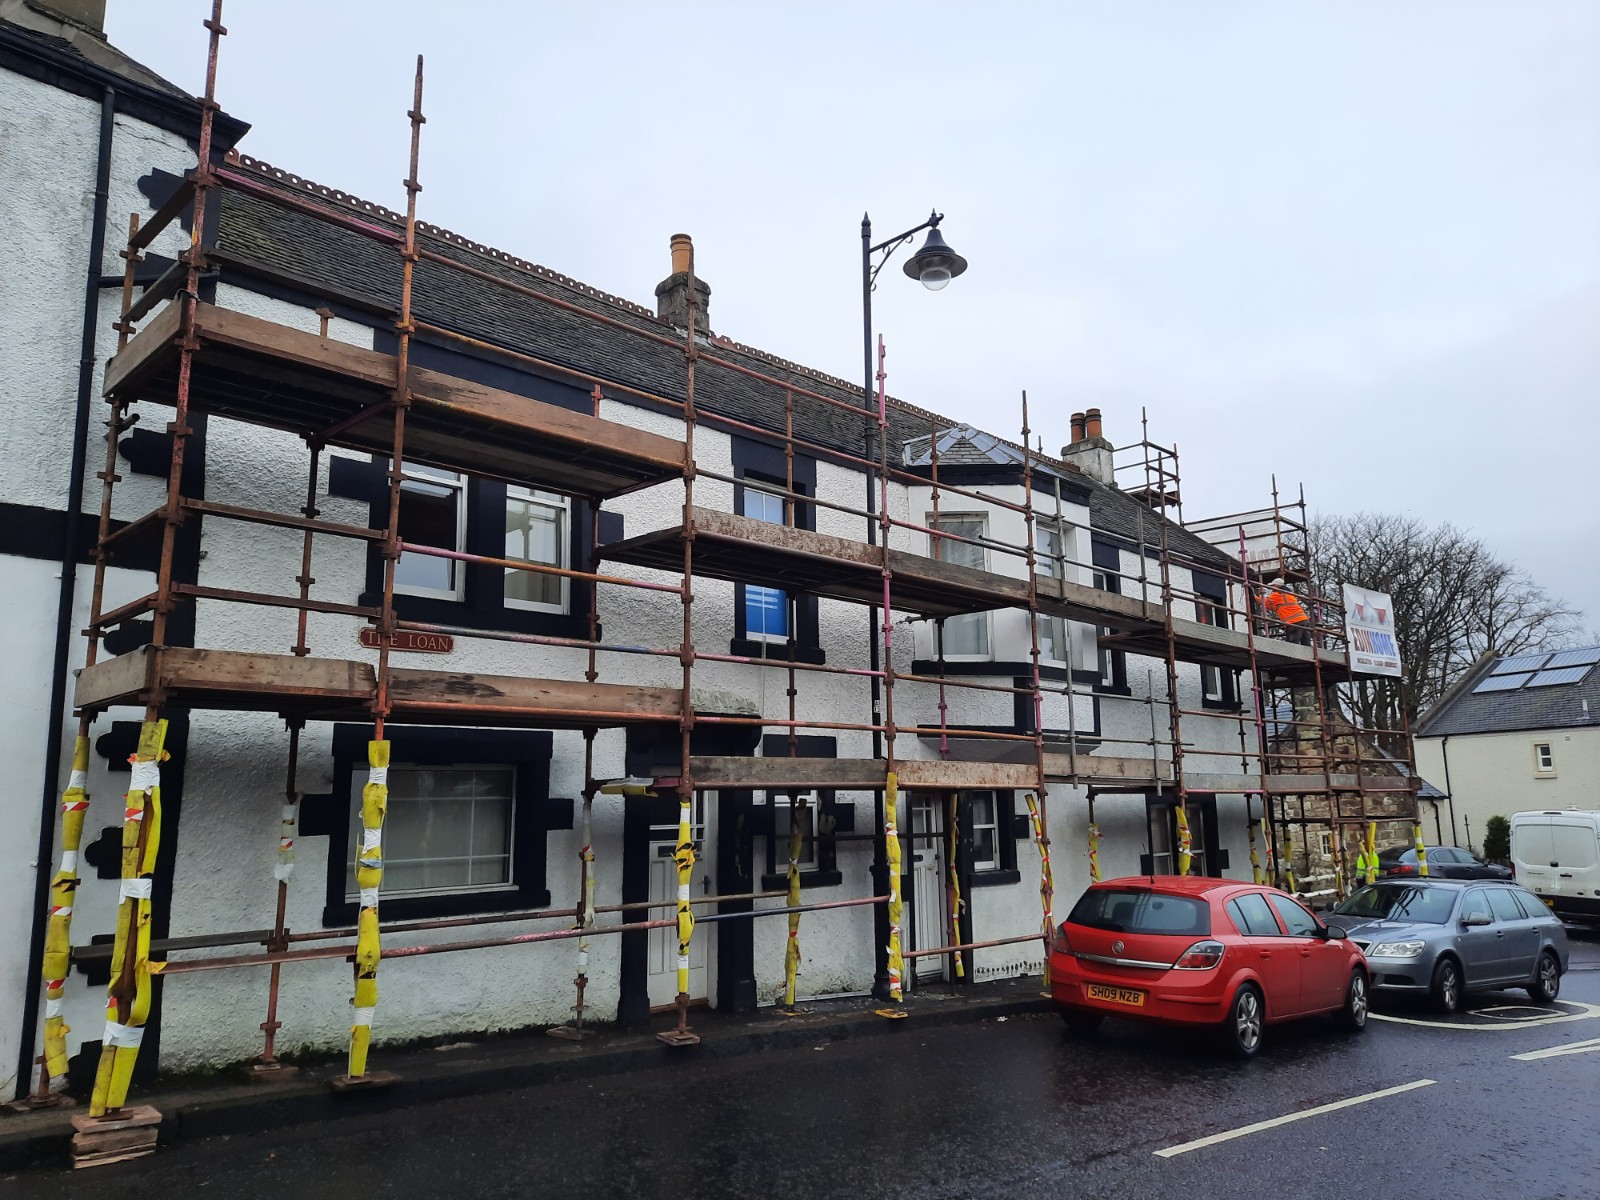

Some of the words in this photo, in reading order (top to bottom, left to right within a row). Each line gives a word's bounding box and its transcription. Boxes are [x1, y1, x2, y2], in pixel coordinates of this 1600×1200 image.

[409, 635, 449, 650] LOAN
[1091, 986, 1117, 999] SH09
[1119, 990, 1140, 1003] NZB
